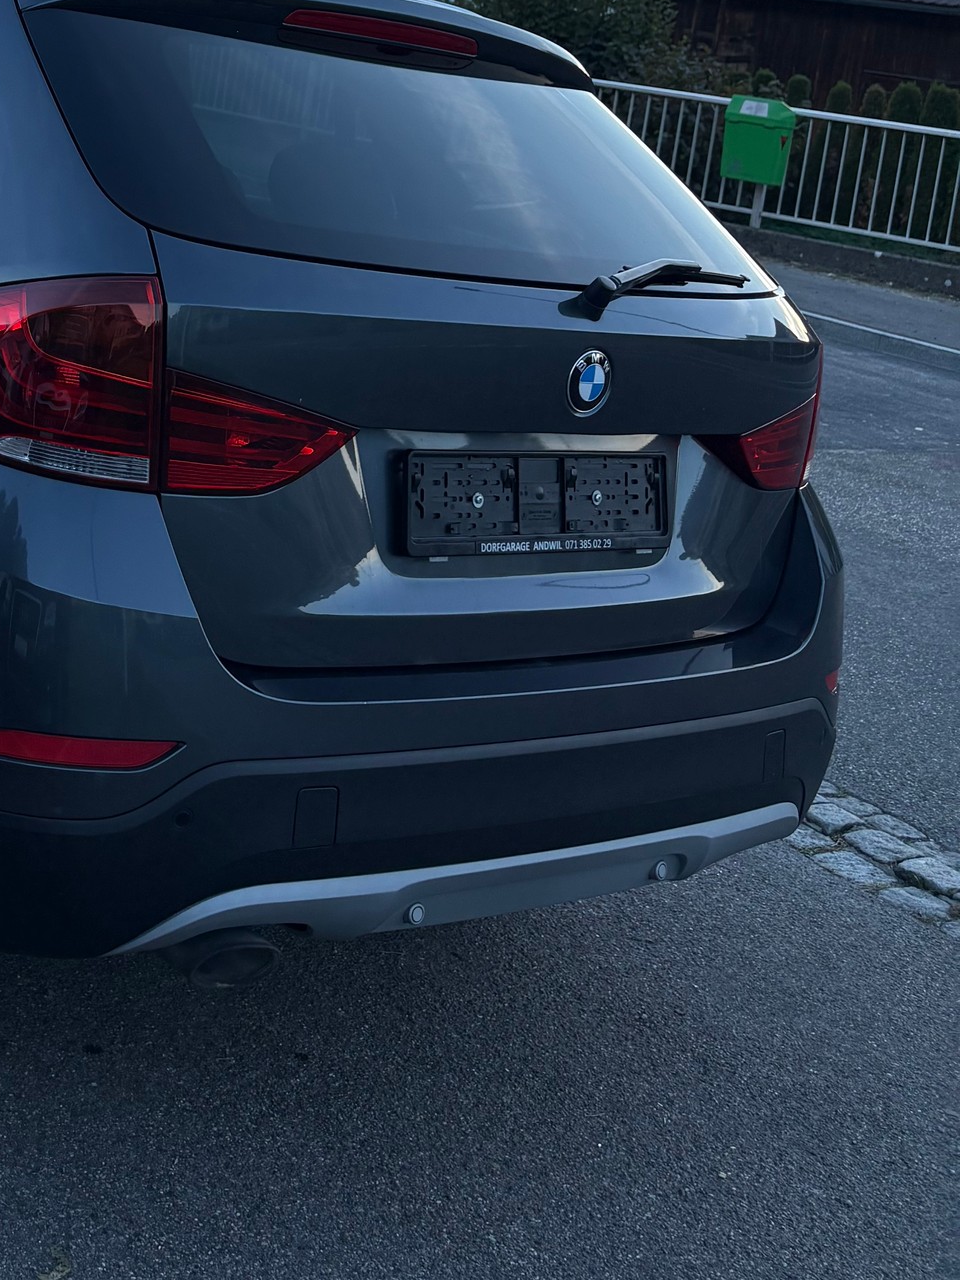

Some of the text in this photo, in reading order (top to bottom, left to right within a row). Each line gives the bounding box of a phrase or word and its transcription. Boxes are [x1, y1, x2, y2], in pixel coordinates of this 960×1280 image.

[575, 352, 611, 373] BMW
[480, 538, 612, 553] DORFGARAGE ANDWIL 071 385 02 29
